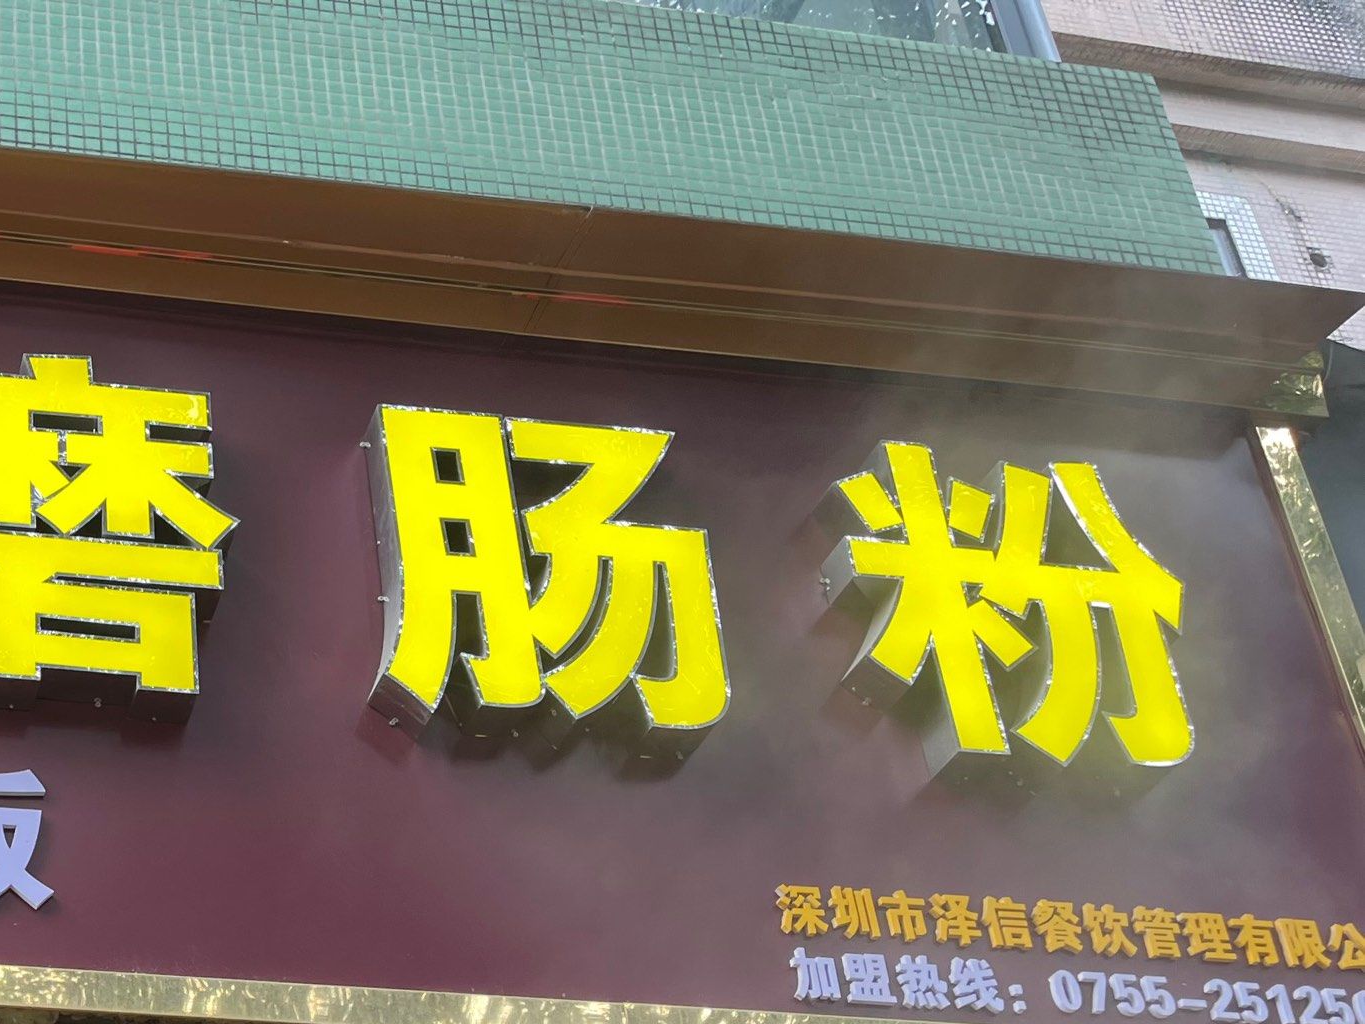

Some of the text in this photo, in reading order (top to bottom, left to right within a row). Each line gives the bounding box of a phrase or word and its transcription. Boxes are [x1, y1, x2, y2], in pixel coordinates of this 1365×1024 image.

[775, 884, 1365, 970] 深圳市泽信餐饮管理有限公
